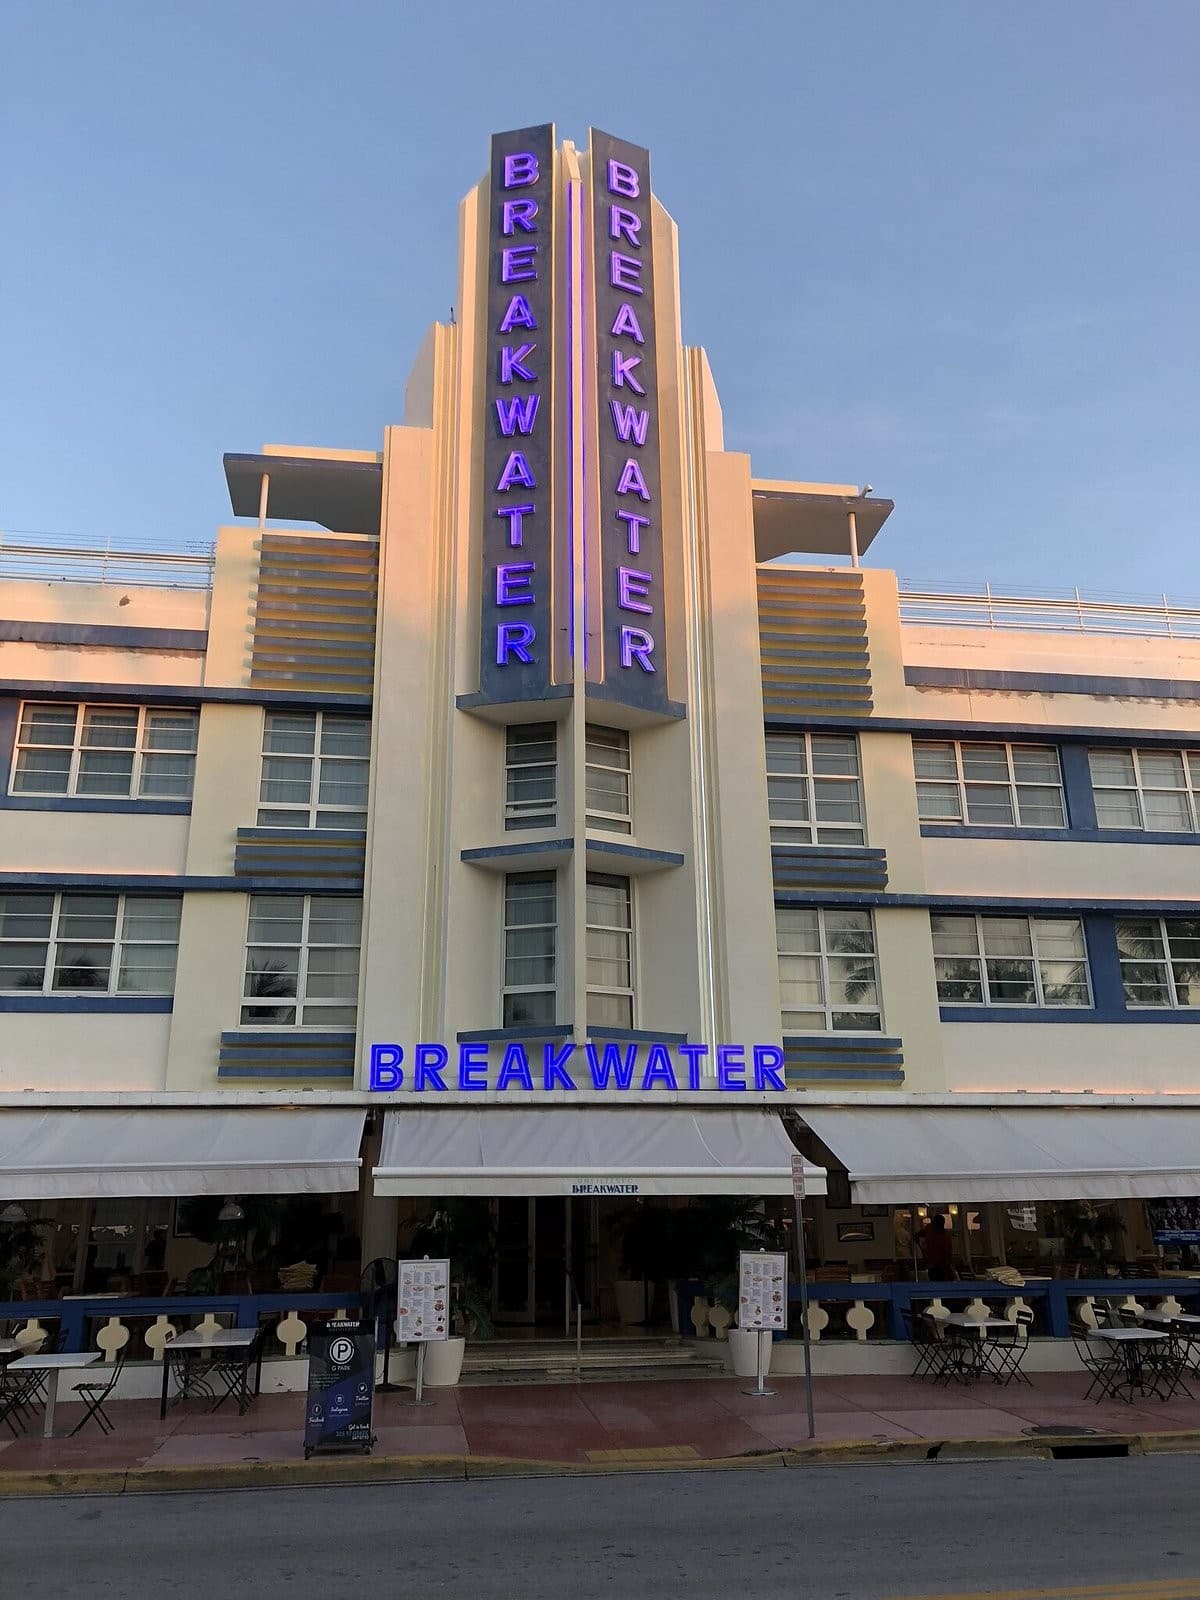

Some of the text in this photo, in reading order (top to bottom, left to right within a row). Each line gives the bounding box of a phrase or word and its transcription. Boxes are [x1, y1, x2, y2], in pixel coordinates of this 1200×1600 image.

[496, 153, 540, 666] BREAKWATER
[608, 158, 656, 673] BREAKWATER
[370, 1044, 787, 1092] BREAKWATER
[572, 1184, 639, 1194] BREAKWATER
